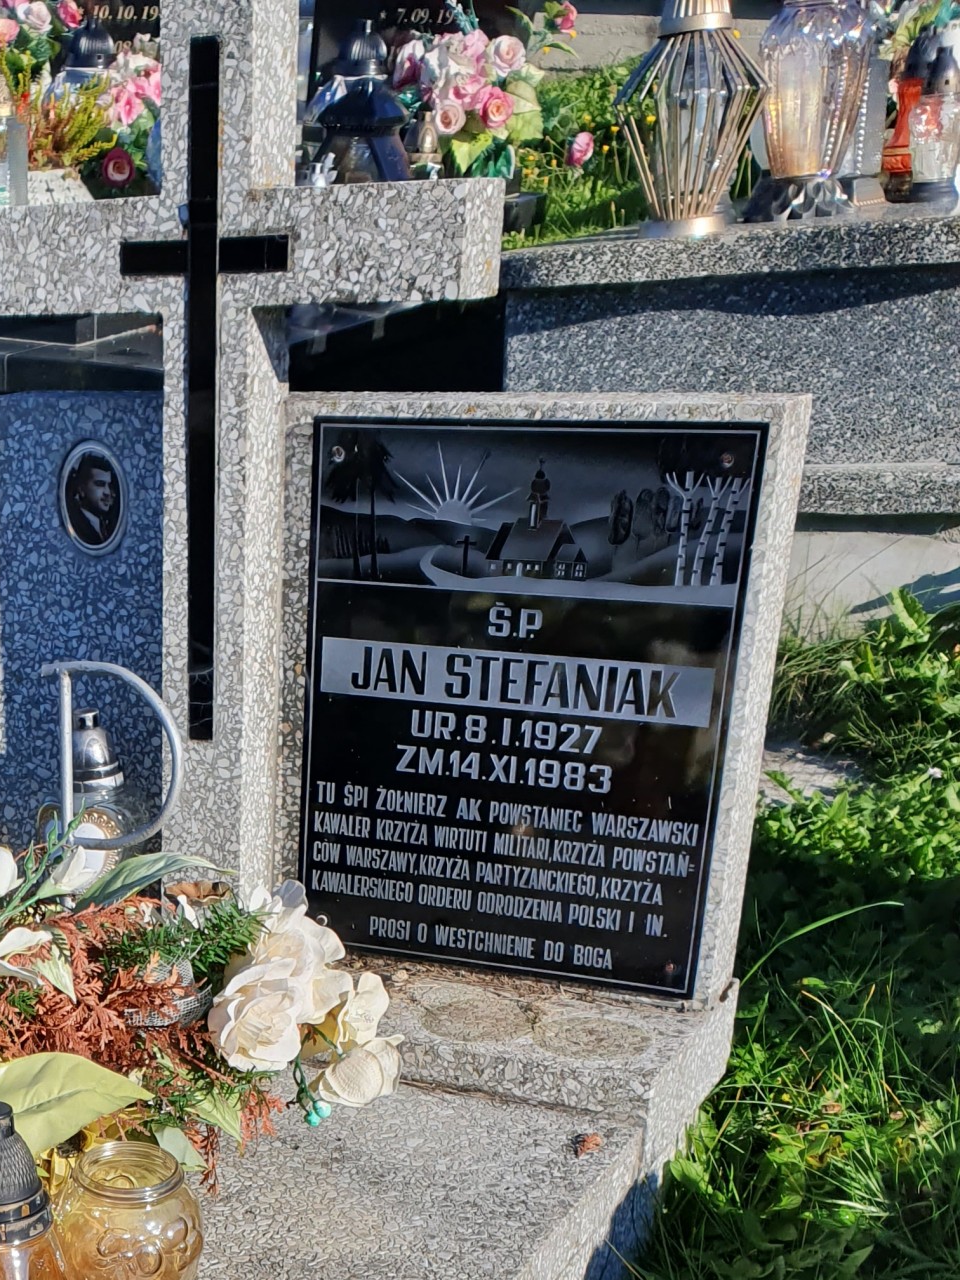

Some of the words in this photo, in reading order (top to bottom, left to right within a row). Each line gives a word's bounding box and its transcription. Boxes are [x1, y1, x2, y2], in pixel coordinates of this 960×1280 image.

[351, 646, 427, 696] JAN
[444, 653, 681, 718] STEFANIAK
[314, 810, 371, 839] KAWALER
[376, 818, 428, 846] KRZYŻA
[434, 825, 488, 853] WIRTUTI
[316, 780, 336, 804] TU
[343, 781, 369, 808] ŚPI
[375, 785, 448, 818] ŻOŁNIERZ
[456, 797, 482, 822] AK
[489, 801, 583, 833] POWSTANIEC
[592, 812, 699, 847] WARSZAWSKI
[312, 838, 341, 864] CÓW
[311, 869, 414, 904] KAWALERSKIEGO
[418, 883, 472, 911] ORDERU
[477, 891, 563, 923] ODRODZENIA
[568, 903, 621, 932] POLSKI
[628, 911, 635, 933] I
[645, 913, 668, 938] IN.
[369, 915, 411, 941] PROSI
[417, 922, 428, 944] O
[435, 923, 537, 960] WESTCHNIENIE
[544, 940, 565, 963] DO
[573, 944, 613, 970] BOGA
